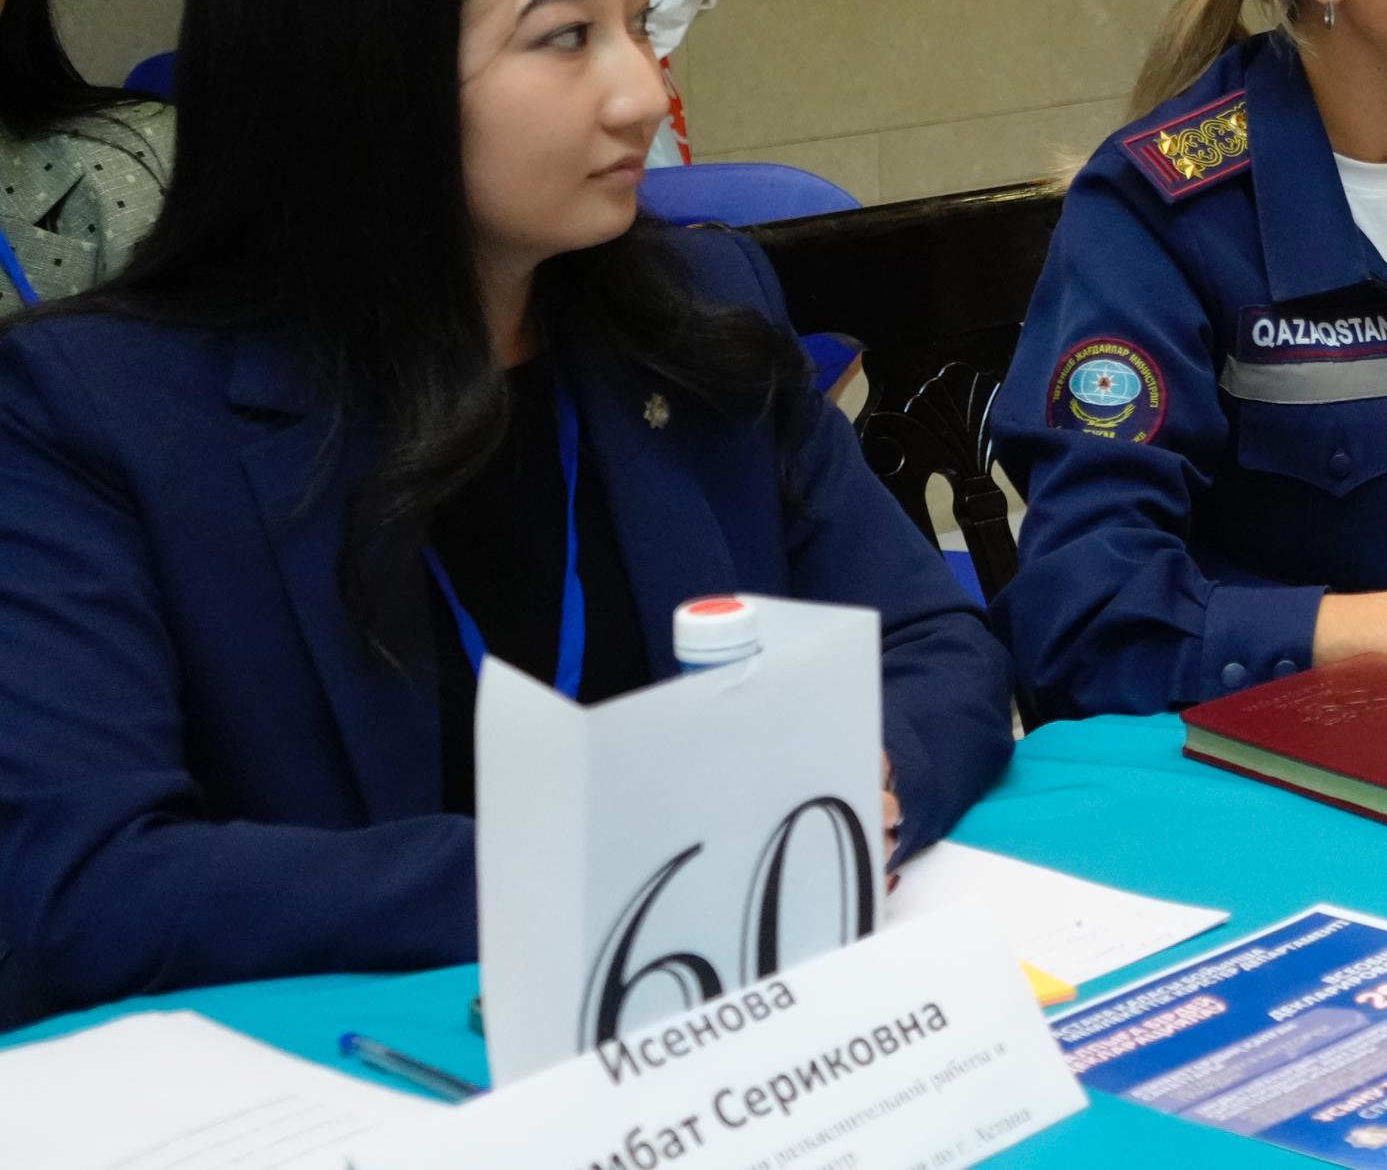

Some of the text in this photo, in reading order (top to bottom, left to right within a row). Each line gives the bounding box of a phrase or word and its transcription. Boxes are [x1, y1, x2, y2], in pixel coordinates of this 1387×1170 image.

[578, 794, 875, 1055] 60
[596, 978, 796, 1085] Исенова
[713, 1000, 950, 1128] Сериковна
